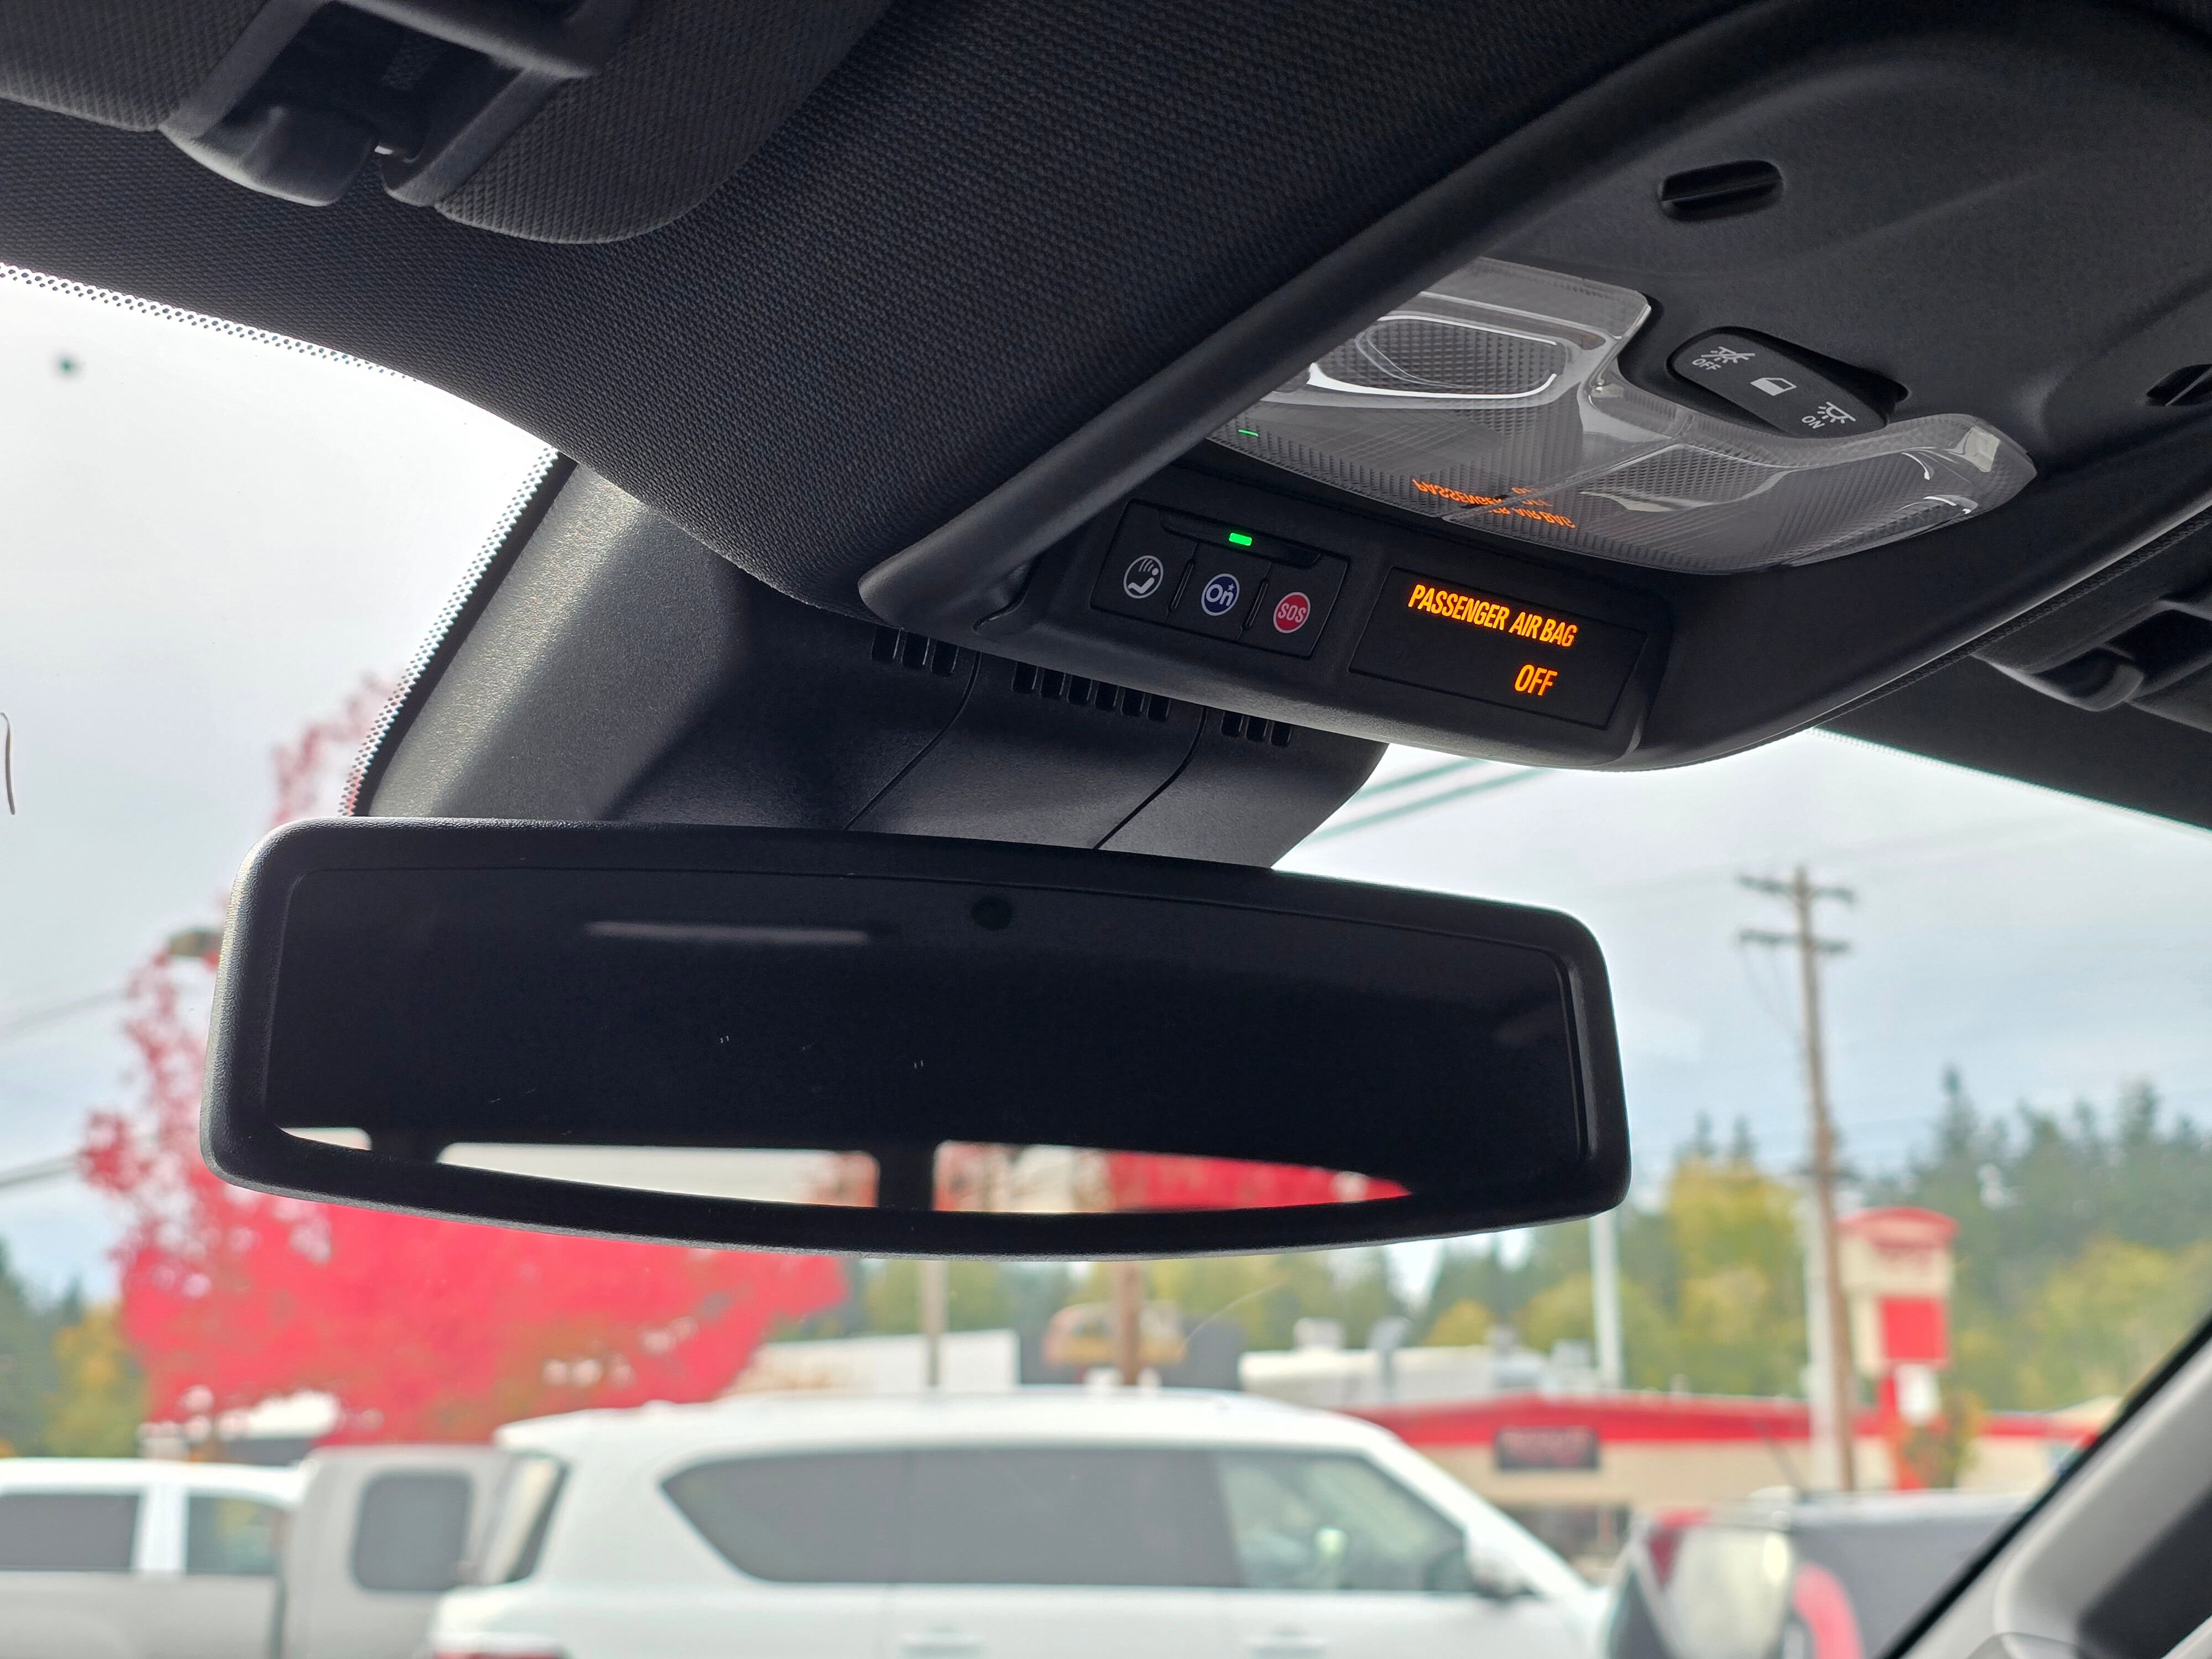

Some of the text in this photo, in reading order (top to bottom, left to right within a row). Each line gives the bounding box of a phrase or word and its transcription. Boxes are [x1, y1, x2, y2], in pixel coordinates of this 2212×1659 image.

[1691, 358, 1721, 371] OFF
[1801, 415, 1825, 429] ON
[1205, 583, 1234, 607] On
[1277, 602, 1307, 624] SOS
[1408, 584, 1578, 648] PASSENGER AIR BAG
[1514, 664, 1558, 696] OFF
